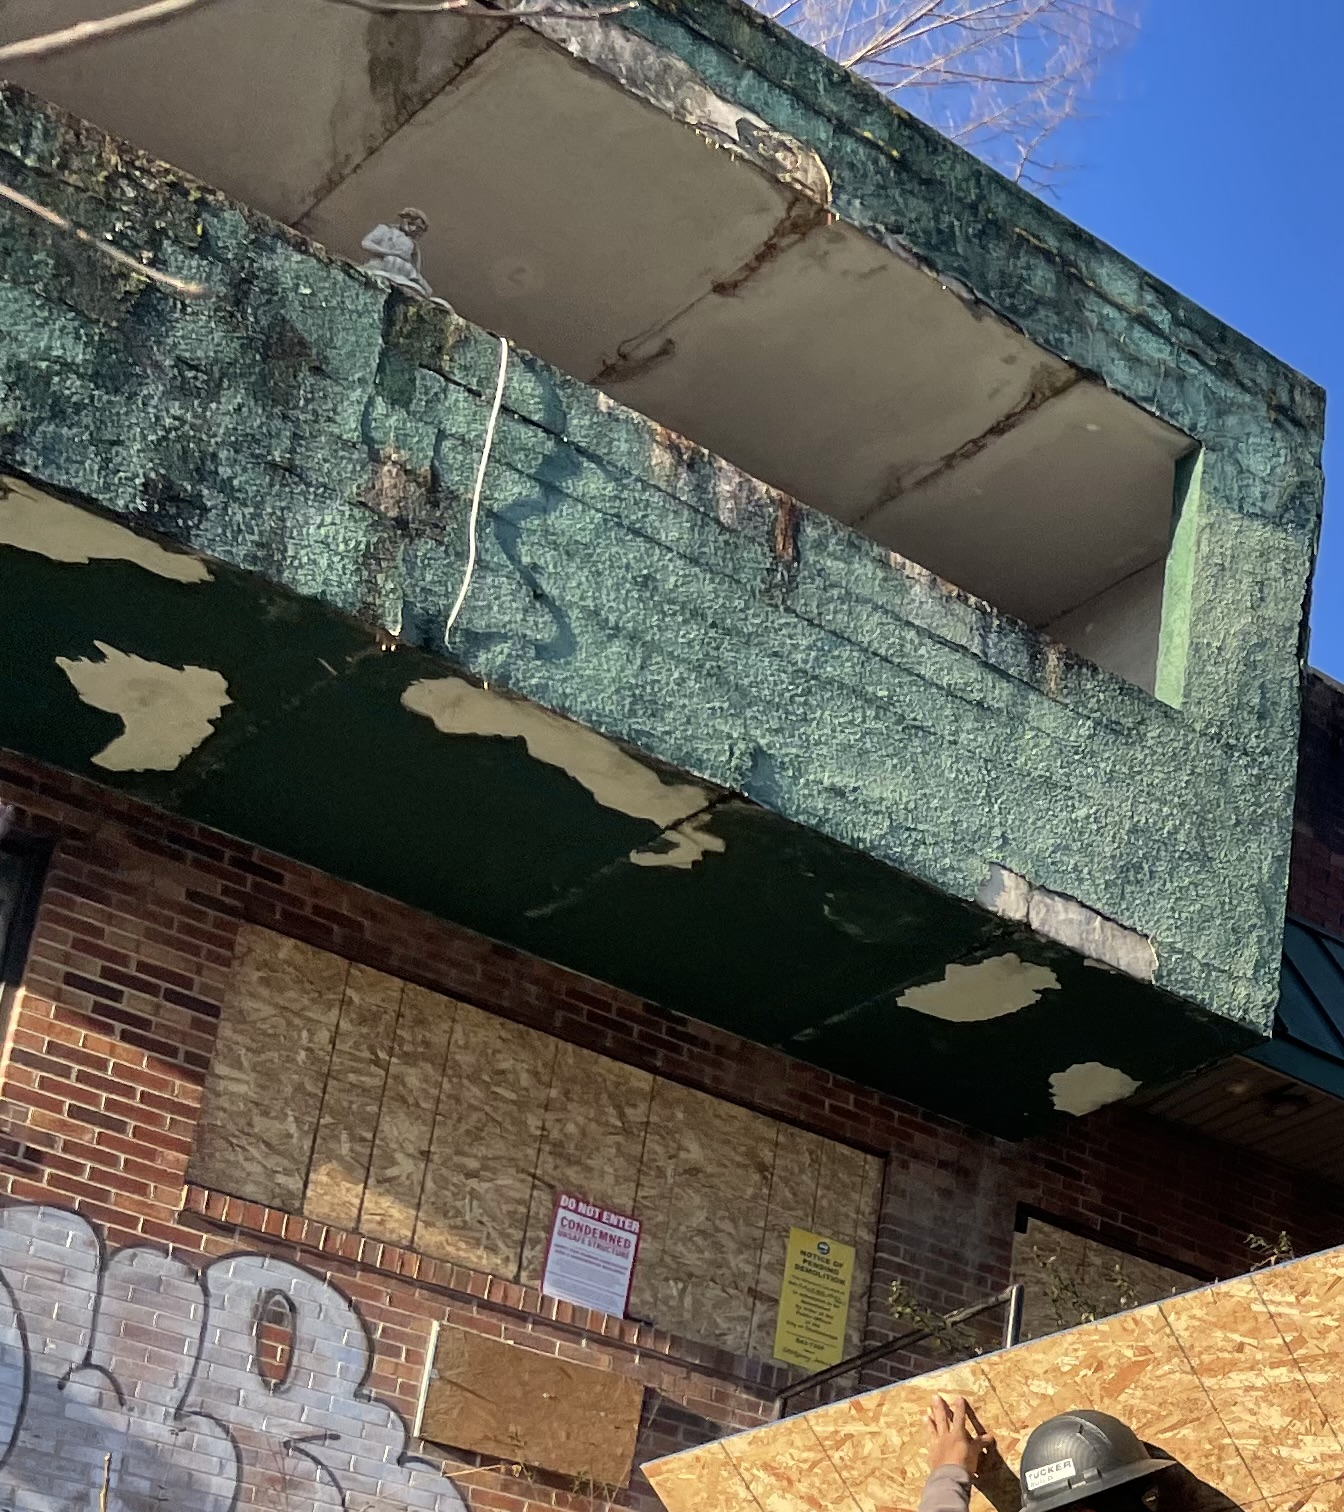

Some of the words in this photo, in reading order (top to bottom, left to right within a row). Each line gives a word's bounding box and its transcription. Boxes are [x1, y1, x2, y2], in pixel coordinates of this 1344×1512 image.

[560, 1194, 577, 1210] DO
[578, 1201, 601, 1220] NOT
[602, 1211, 640, 1233] ENTER
[560, 1215, 632, 1249] CONDEMNED
[800, 1249, 831, 1265] NOTICE
[802, 1258, 840, 1275] PENDING
